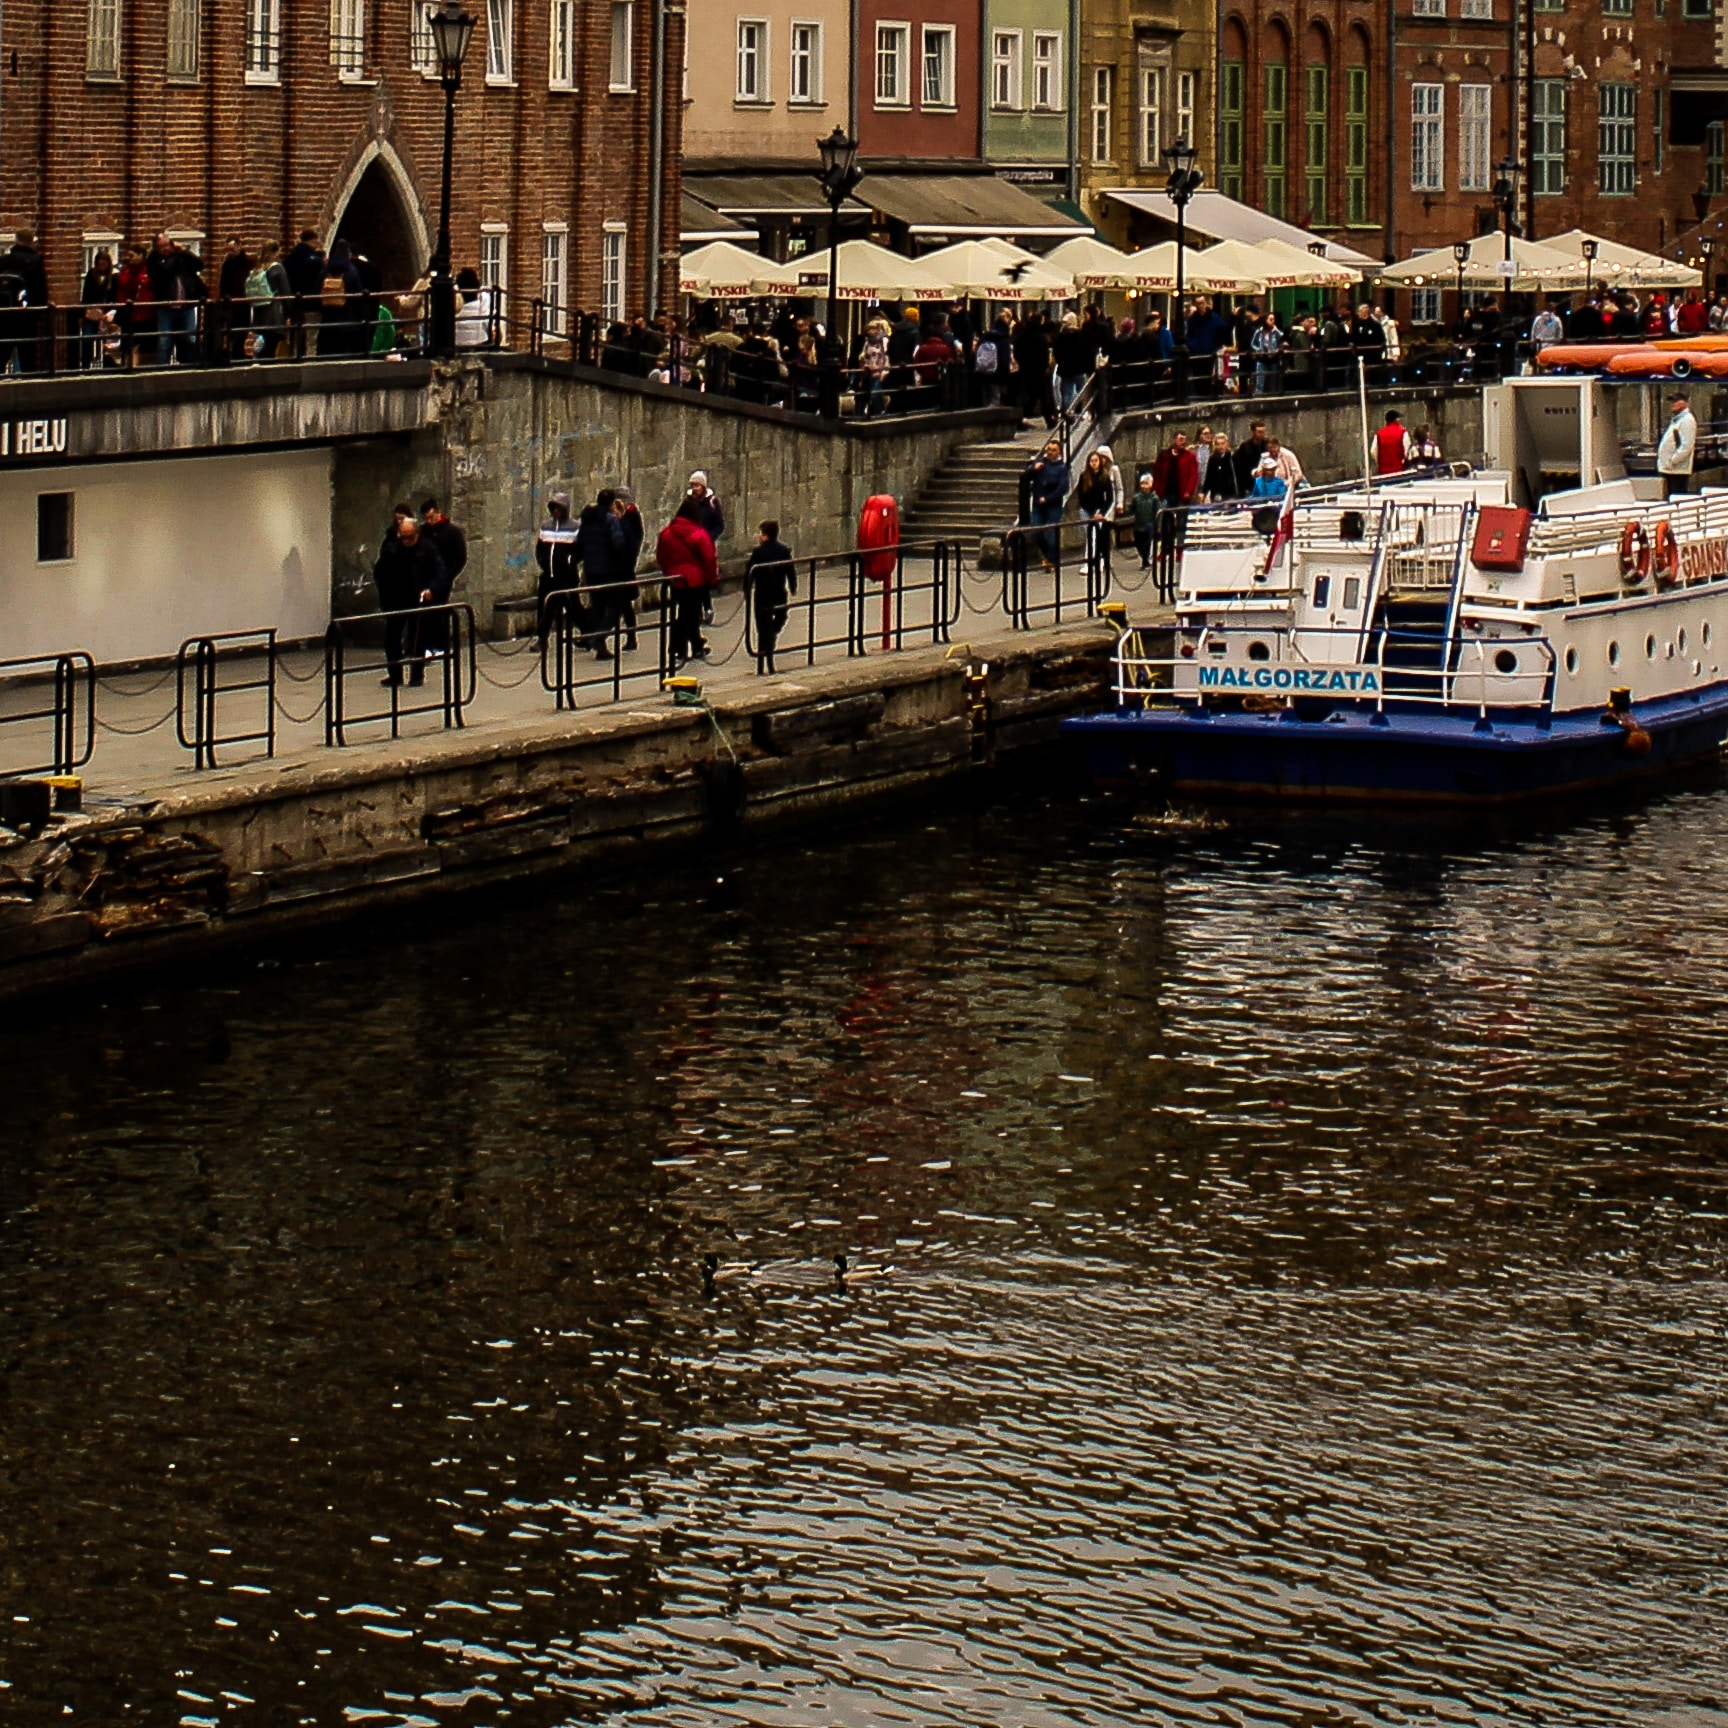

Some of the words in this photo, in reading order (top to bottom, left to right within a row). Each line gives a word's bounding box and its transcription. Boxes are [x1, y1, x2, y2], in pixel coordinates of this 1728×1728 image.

[1136, 276, 1173, 286] TYSKIE
[710, 285, 751, 297] TYSKIE
[838, 286, 878, 298] TYSKIE
[986, 287, 1023, 298] TYSKIE
[1, 421, 10, 456] I
[16, 418, 67, 455] HELU
[1198, 666, 1379, 691] MAŁGORZATA
